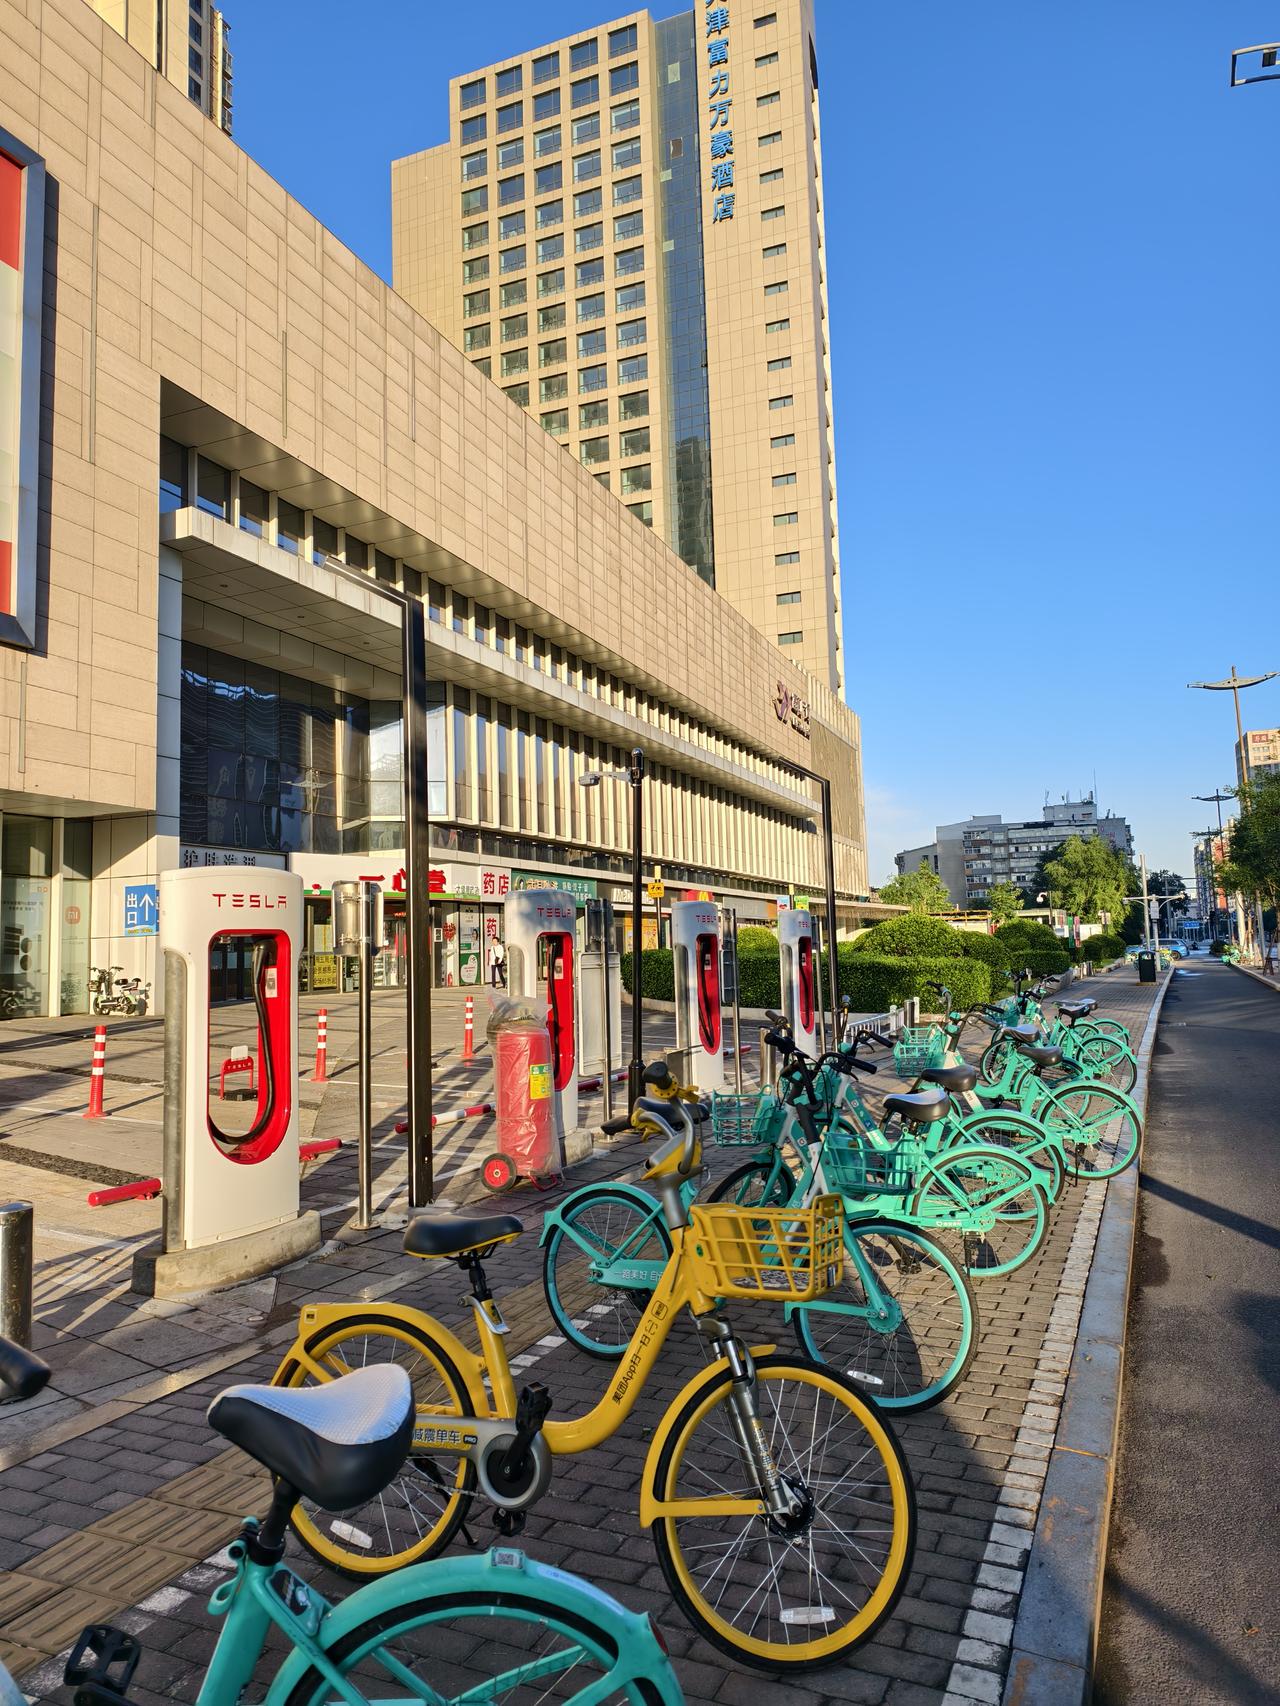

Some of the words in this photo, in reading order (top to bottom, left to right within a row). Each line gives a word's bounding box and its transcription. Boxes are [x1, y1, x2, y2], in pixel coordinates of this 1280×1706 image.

[483, 872, 510, 896] 药店
[126, 893, 138, 924] 出口
[212, 893, 287, 909] TESLA
[537, 907, 573, 919] TESLA
[614, 1269, 648, 1281] 一路美好
[611, 1333, 651, 1406] 美团App扫一扫
[412, 1427, 462, 1445] 减震单车
[464, 1435, 477, 1444] PRO
